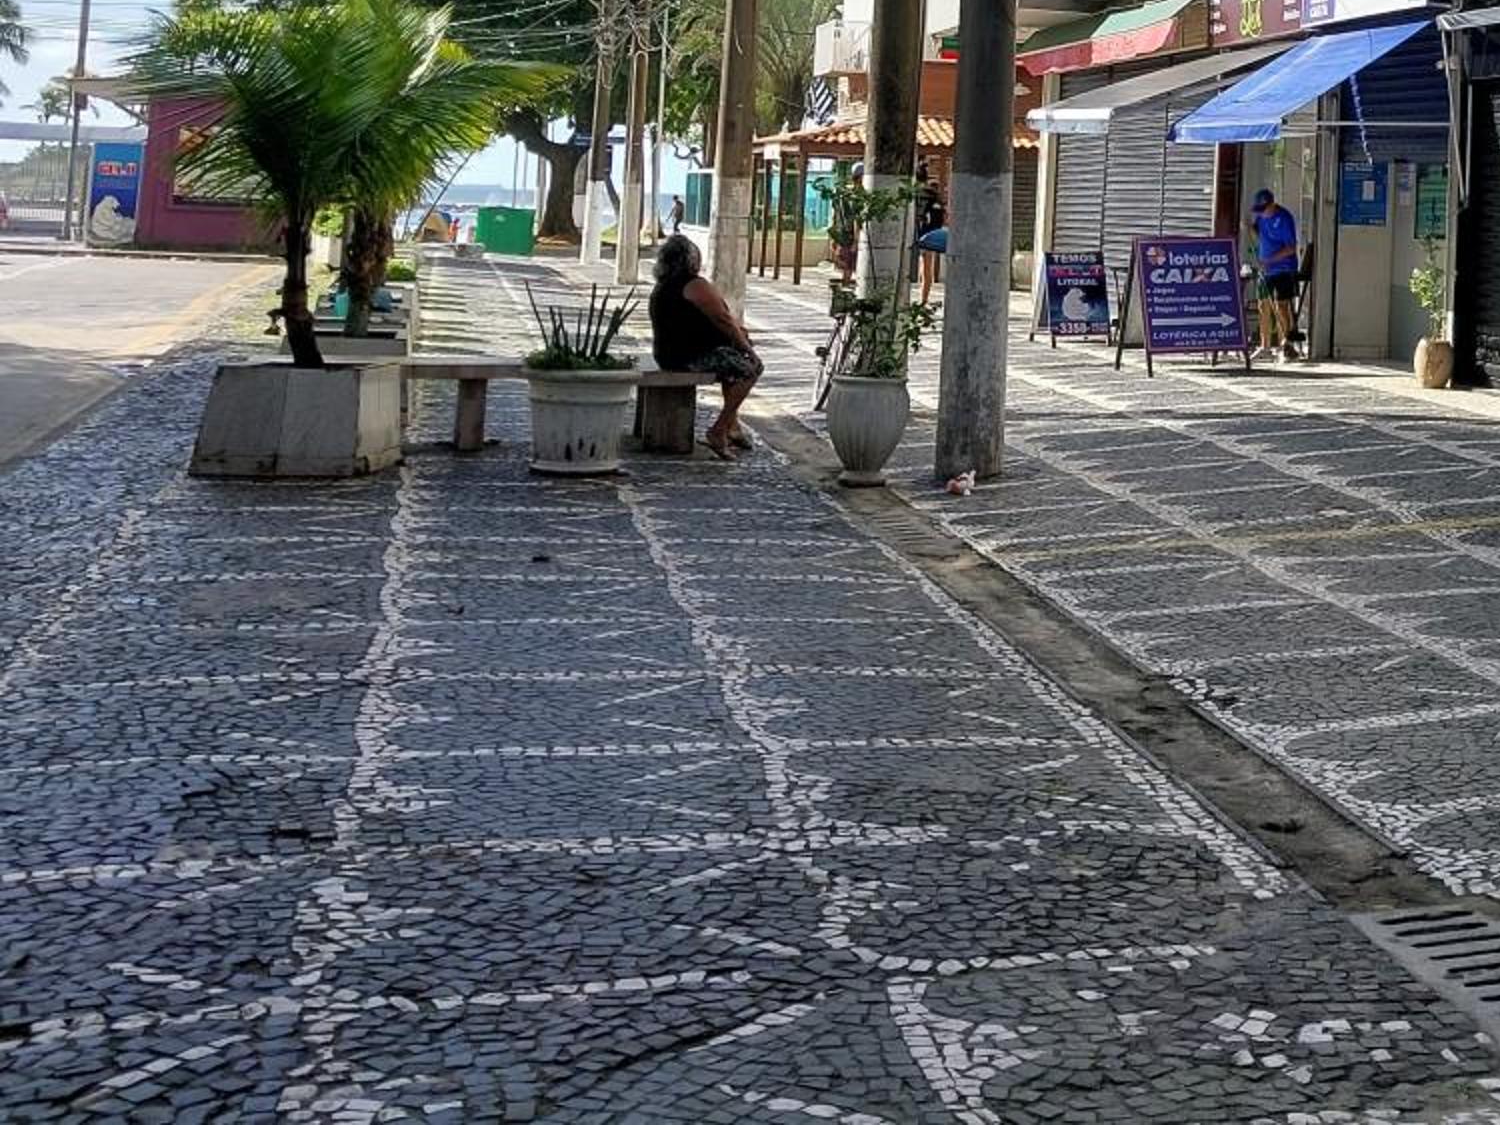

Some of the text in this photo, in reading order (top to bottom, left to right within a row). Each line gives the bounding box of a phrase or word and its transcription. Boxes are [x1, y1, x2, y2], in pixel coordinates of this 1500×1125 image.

[1053, 254, 1097, 263] TEMOS
[1168, 251, 1229, 266] loterias
[1150, 266, 1230, 284] CAIXA
